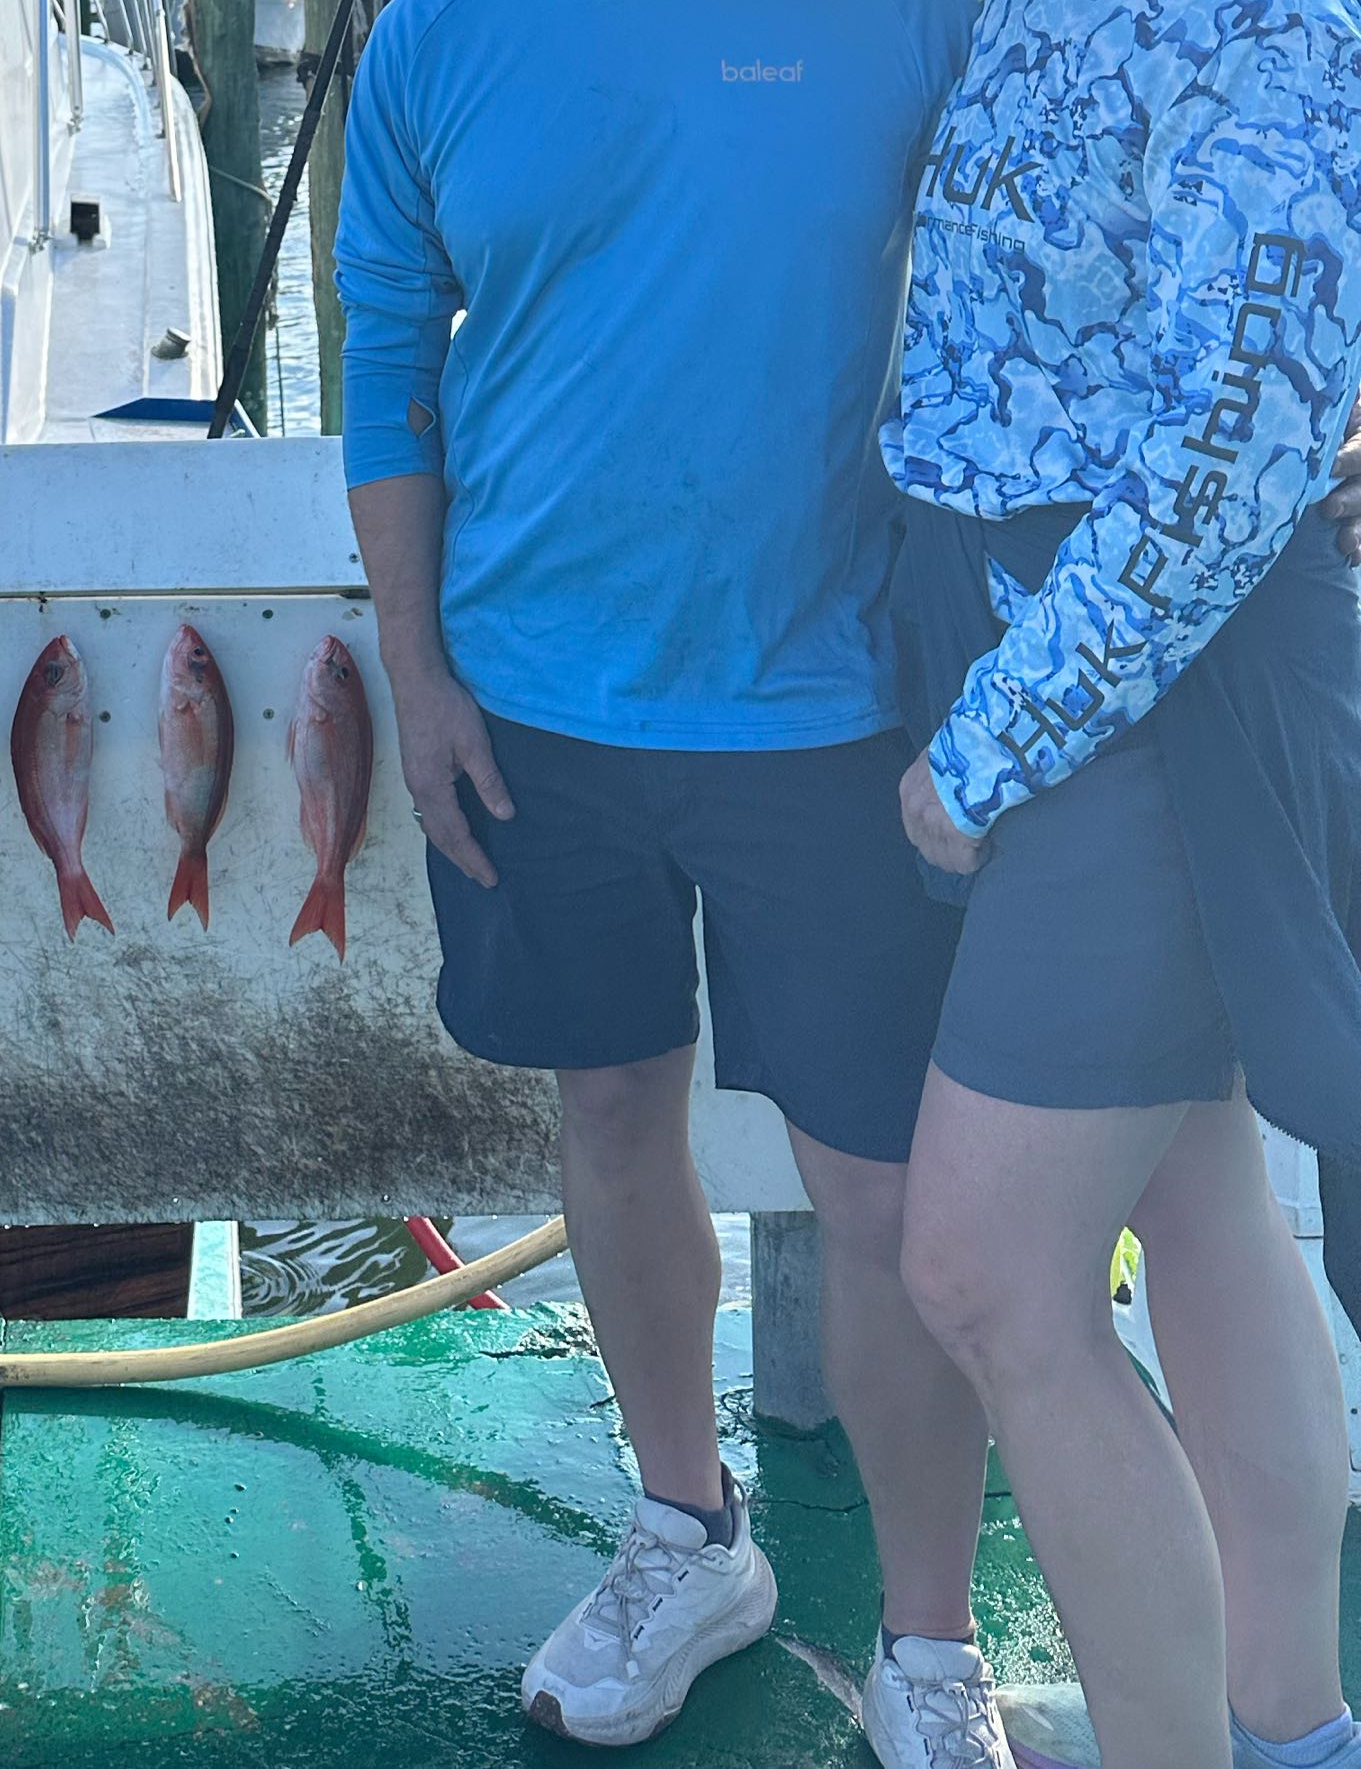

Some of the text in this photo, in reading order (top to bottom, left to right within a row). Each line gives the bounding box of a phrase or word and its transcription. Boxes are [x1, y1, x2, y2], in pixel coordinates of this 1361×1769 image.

[721, 58, 804, 82] baleaf
[997, 232, 1307, 774] Huk Fishing
